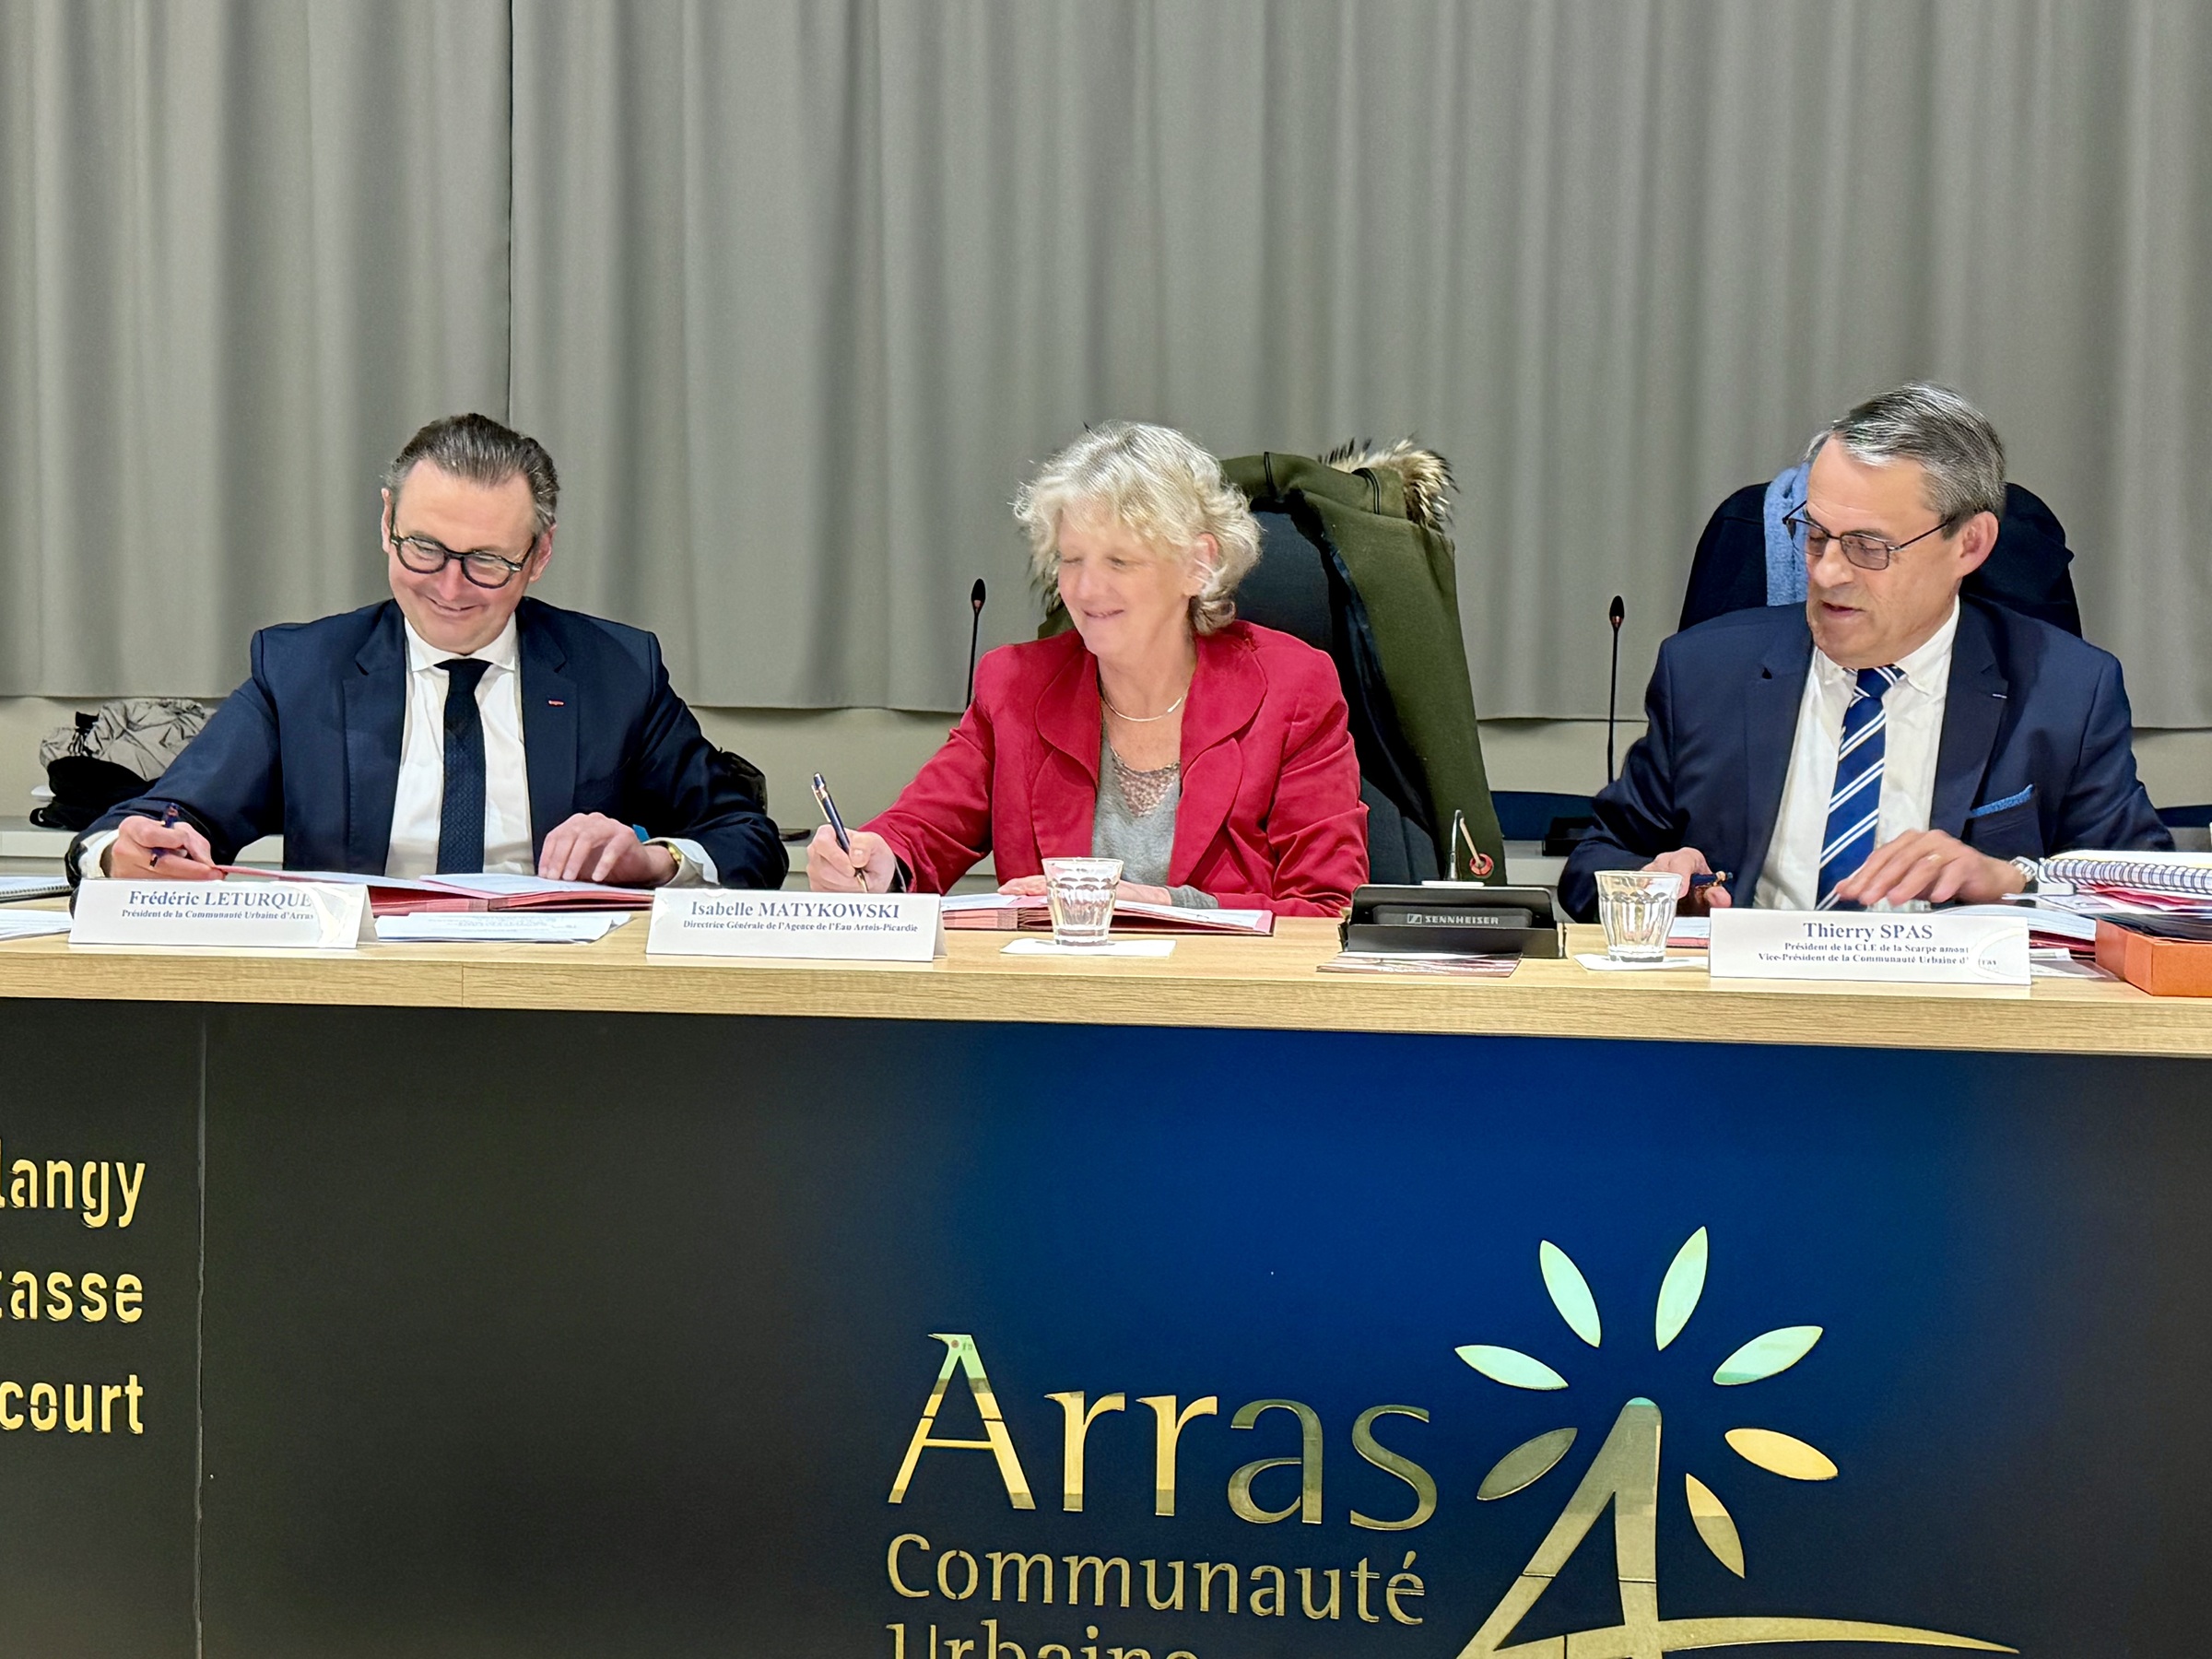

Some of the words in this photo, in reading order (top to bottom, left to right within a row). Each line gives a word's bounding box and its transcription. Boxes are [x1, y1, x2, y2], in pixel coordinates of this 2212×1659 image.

[129, 890, 200, 905] Frédéric
[205, 891, 312, 910] LETURQUE
[122, 909, 161, 918] Président
[163, 910, 173, 918] de
[185, 911, 242, 919] Communauté
[244, 911, 278, 920] Urbaine
[691, 901, 754, 916] Isabelle
[758, 902, 900, 919] MATYKOWSKI
[1424, 915, 1500, 924] SENNHEISER
[683, 920, 724, 929] Directrice
[726, 921, 765, 930] Générale
[766, 922, 776, 930] de
[778, 922, 814, 932] l'Agence
[816, 923, 827, 931] de
[829, 923, 852, 931] l'Eau
[1803, 923, 1875, 943] Thierry
[1879, 924, 1933, 939] SPAS
[1784, 942, 1828, 951] Président
[1830, 943, 1841, 951] de
[1843, 943, 1853, 951] la
[1879, 944, 1890, 952] de
[1893, 944, 1902, 952] la
[1904, 945, 1937, 955] Scarpe
[1828, 953, 1839, 961] de
[1853, 954, 1916, 963] Communauté
[1919, 956, 1957, 964] Urbaine
[0, 1141, 146, 1228] angy
[0, 1270, 144, 1323] asse
[887, 1333, 1438, 1531] Arras
[886, 1533, 1426, 1626] Communauté
